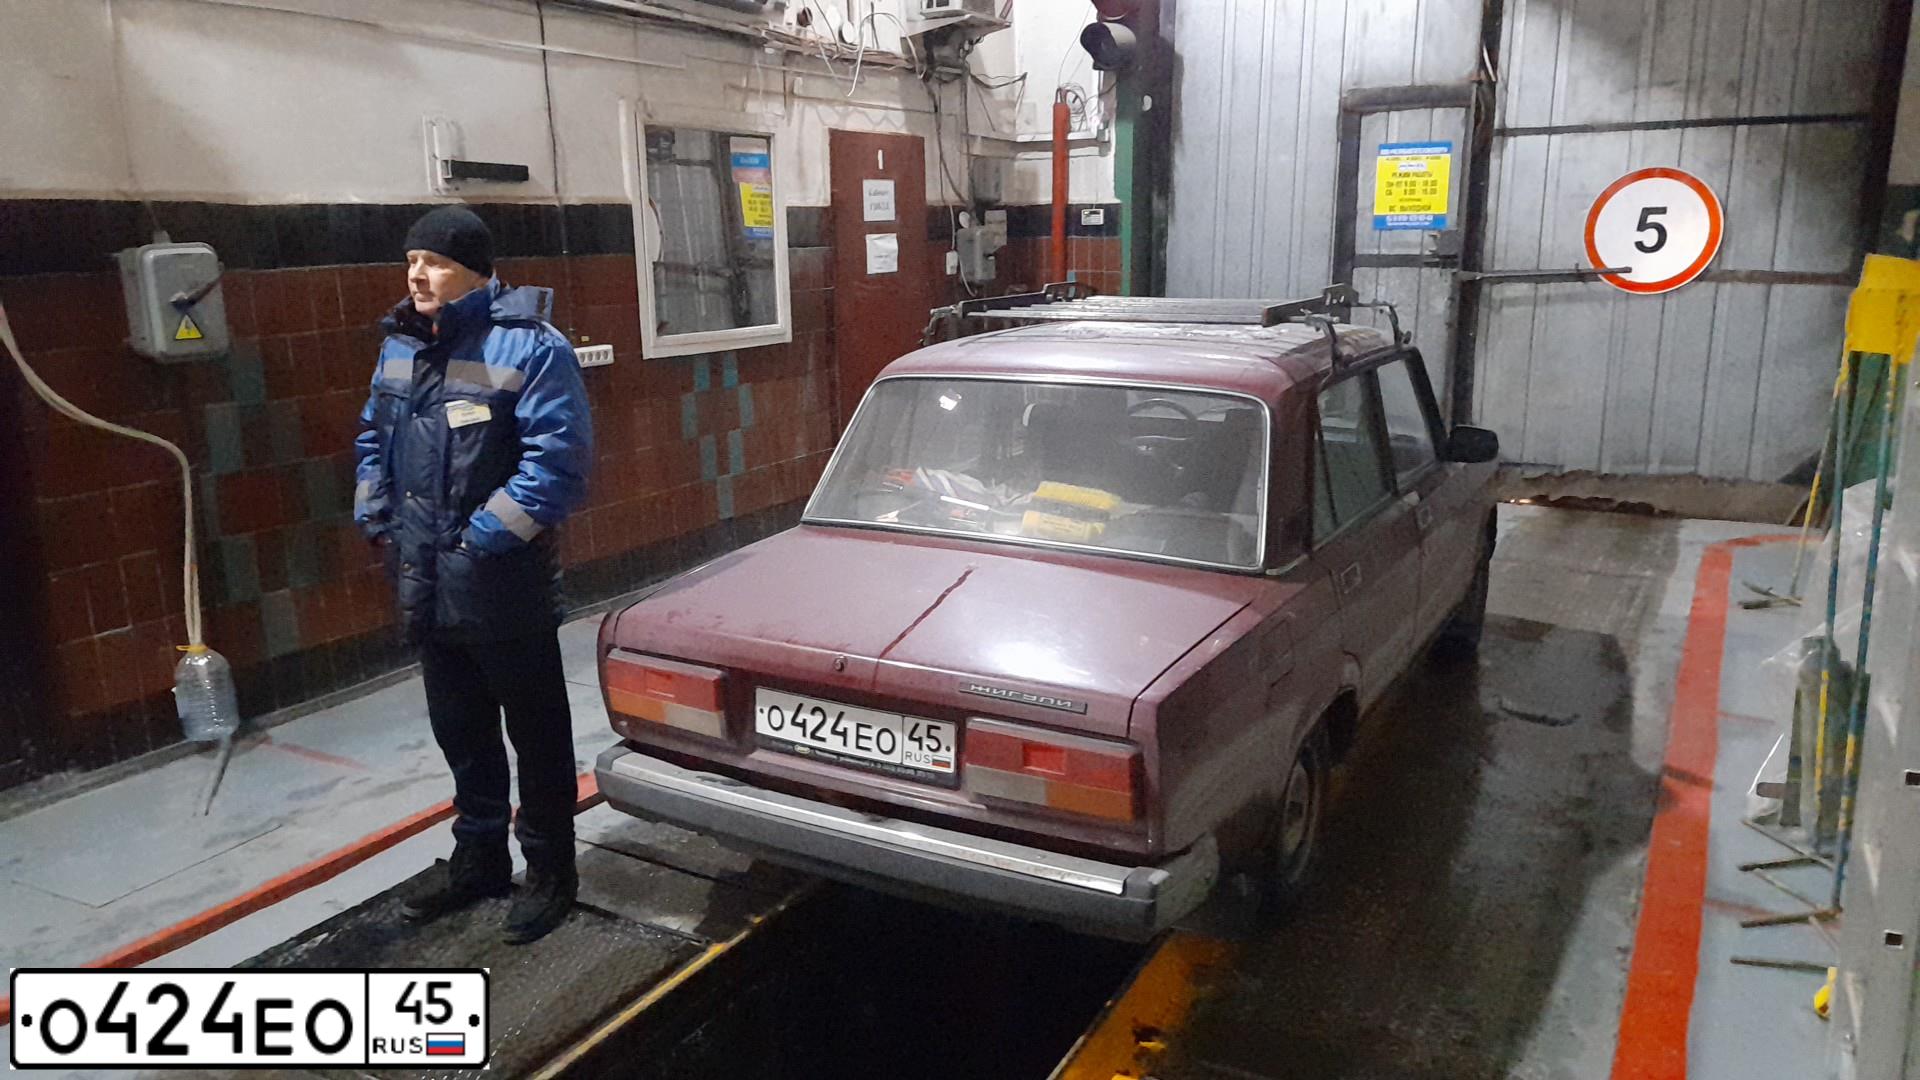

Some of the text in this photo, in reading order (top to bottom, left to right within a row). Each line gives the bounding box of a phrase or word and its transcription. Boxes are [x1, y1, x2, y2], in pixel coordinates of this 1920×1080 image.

[1634, 206, 1668, 254] 5
[908, 722, 942, 752] 45
[904, 751, 931, 764] RUS
